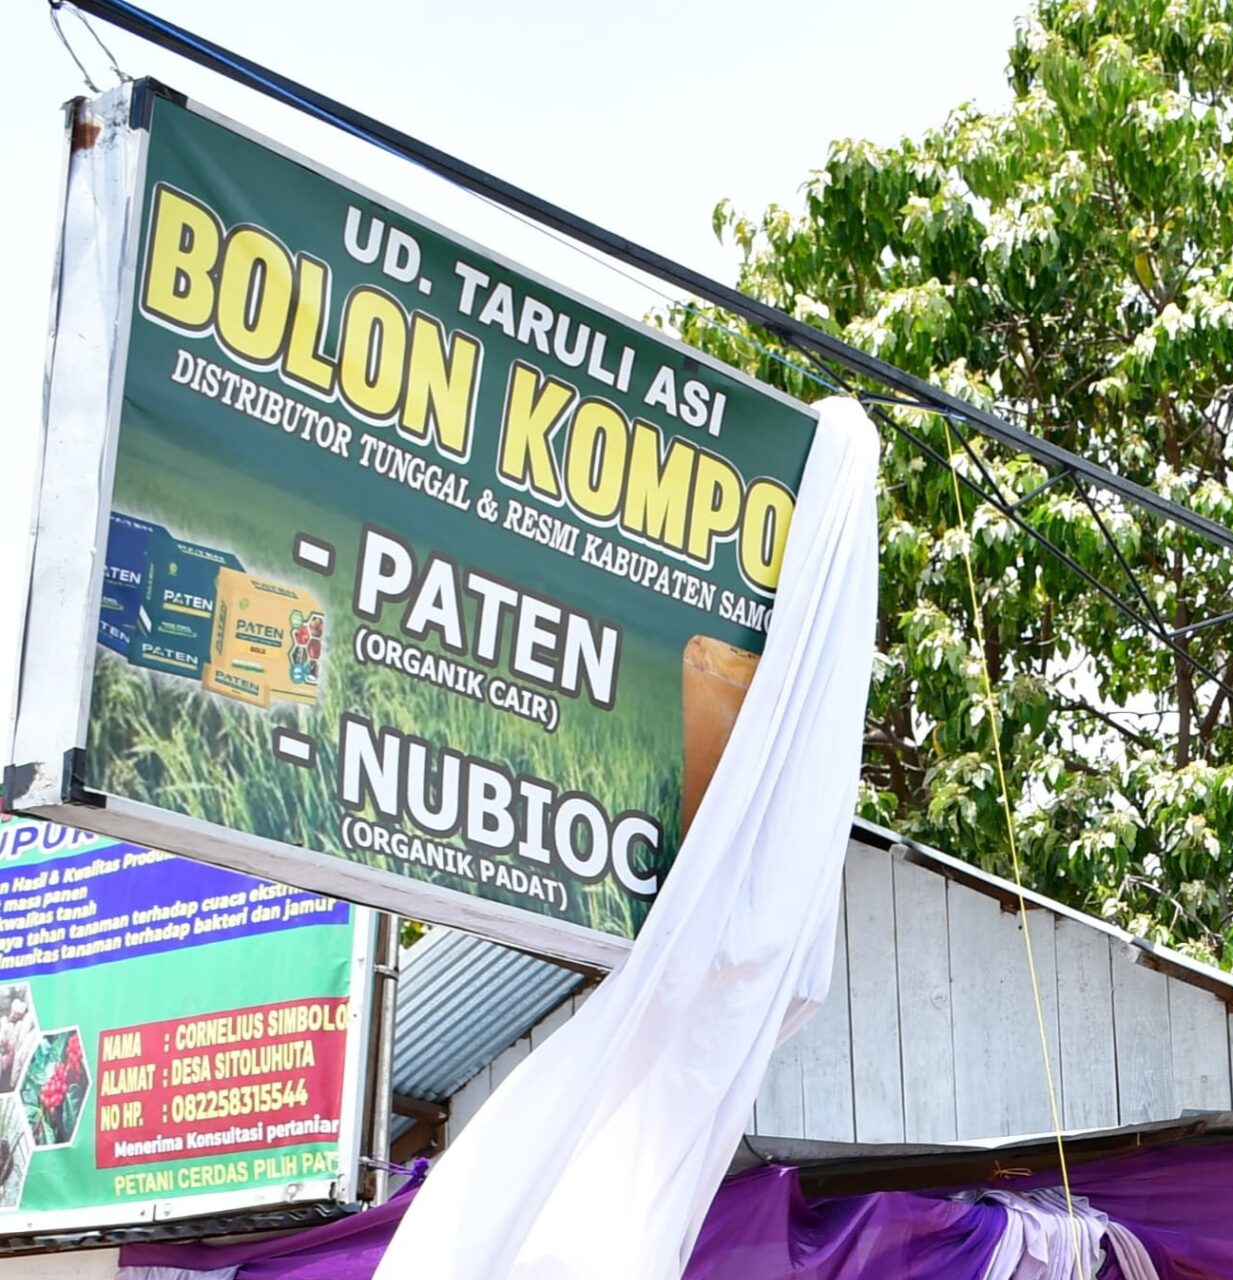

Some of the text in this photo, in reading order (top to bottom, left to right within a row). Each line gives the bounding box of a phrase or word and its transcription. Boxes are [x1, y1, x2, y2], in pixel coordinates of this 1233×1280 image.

[342, 205, 727, 438] UD. TARULI ASI
[141, 182, 797, 597] BOLON KOMPO
[171, 349, 353, 458] DISTRIBUTOR
[359, 433, 472, 512] TUNGGAL
[476, 488, 499, 523] &
[503, 499, 581, 557] RESMI
[581, 533, 717, 613] KABUPATEN
[163, 589, 213, 612] PATEN
[357, 529, 618, 705] PATEN
[142, 643, 199, 665] PATEN
[236, 618, 284, 640] PATEN
[214, 669, 260, 692] PATEN
[355, 628, 559, 730] (ORGANIK CAIR)
[341, 719, 659, 896] NUBIOC
[12, 871, 48, 893] Hasil
[62, 858, 121, 884] Kwalitas
[341, 816, 569, 912] (ORGANIK PADAT)
[3, 886, 88, 913] masa panen
[27, 927, 66, 947] tahan
[69, 915, 129, 940] tanaman
[132, 898, 199, 926] terhadap
[201, 891, 247, 912] cuaca
[56, 899, 97, 922] tanah
[61, 936, 122, 960] tanaman
[125, 921, 191, 947] terhadap
[193, 906, 249, 935] bakteri
[250, 904, 281, 924] dan
[282, 897, 337, 922] jamur
[102, 1031, 142, 1063] NAMA
[175, 1011, 264, 1051] CORNELIUS
[101, 1063, 156, 1097] ALAMAT
[171, 1053, 212, 1087] DESA
[214, 1039, 316, 1080] SITOLUHUTA
[100, 1106, 120, 1132] NO
[123, 1101, 144, 1128] HP.
[171, 1077, 309, 1124] 082258315544
[114, 1133, 184, 1159] Menerima
[186, 1121, 263, 1151] Konsultasi
[114, 1149, 338, 1197] PETANI CERDAS PILIH PAT
